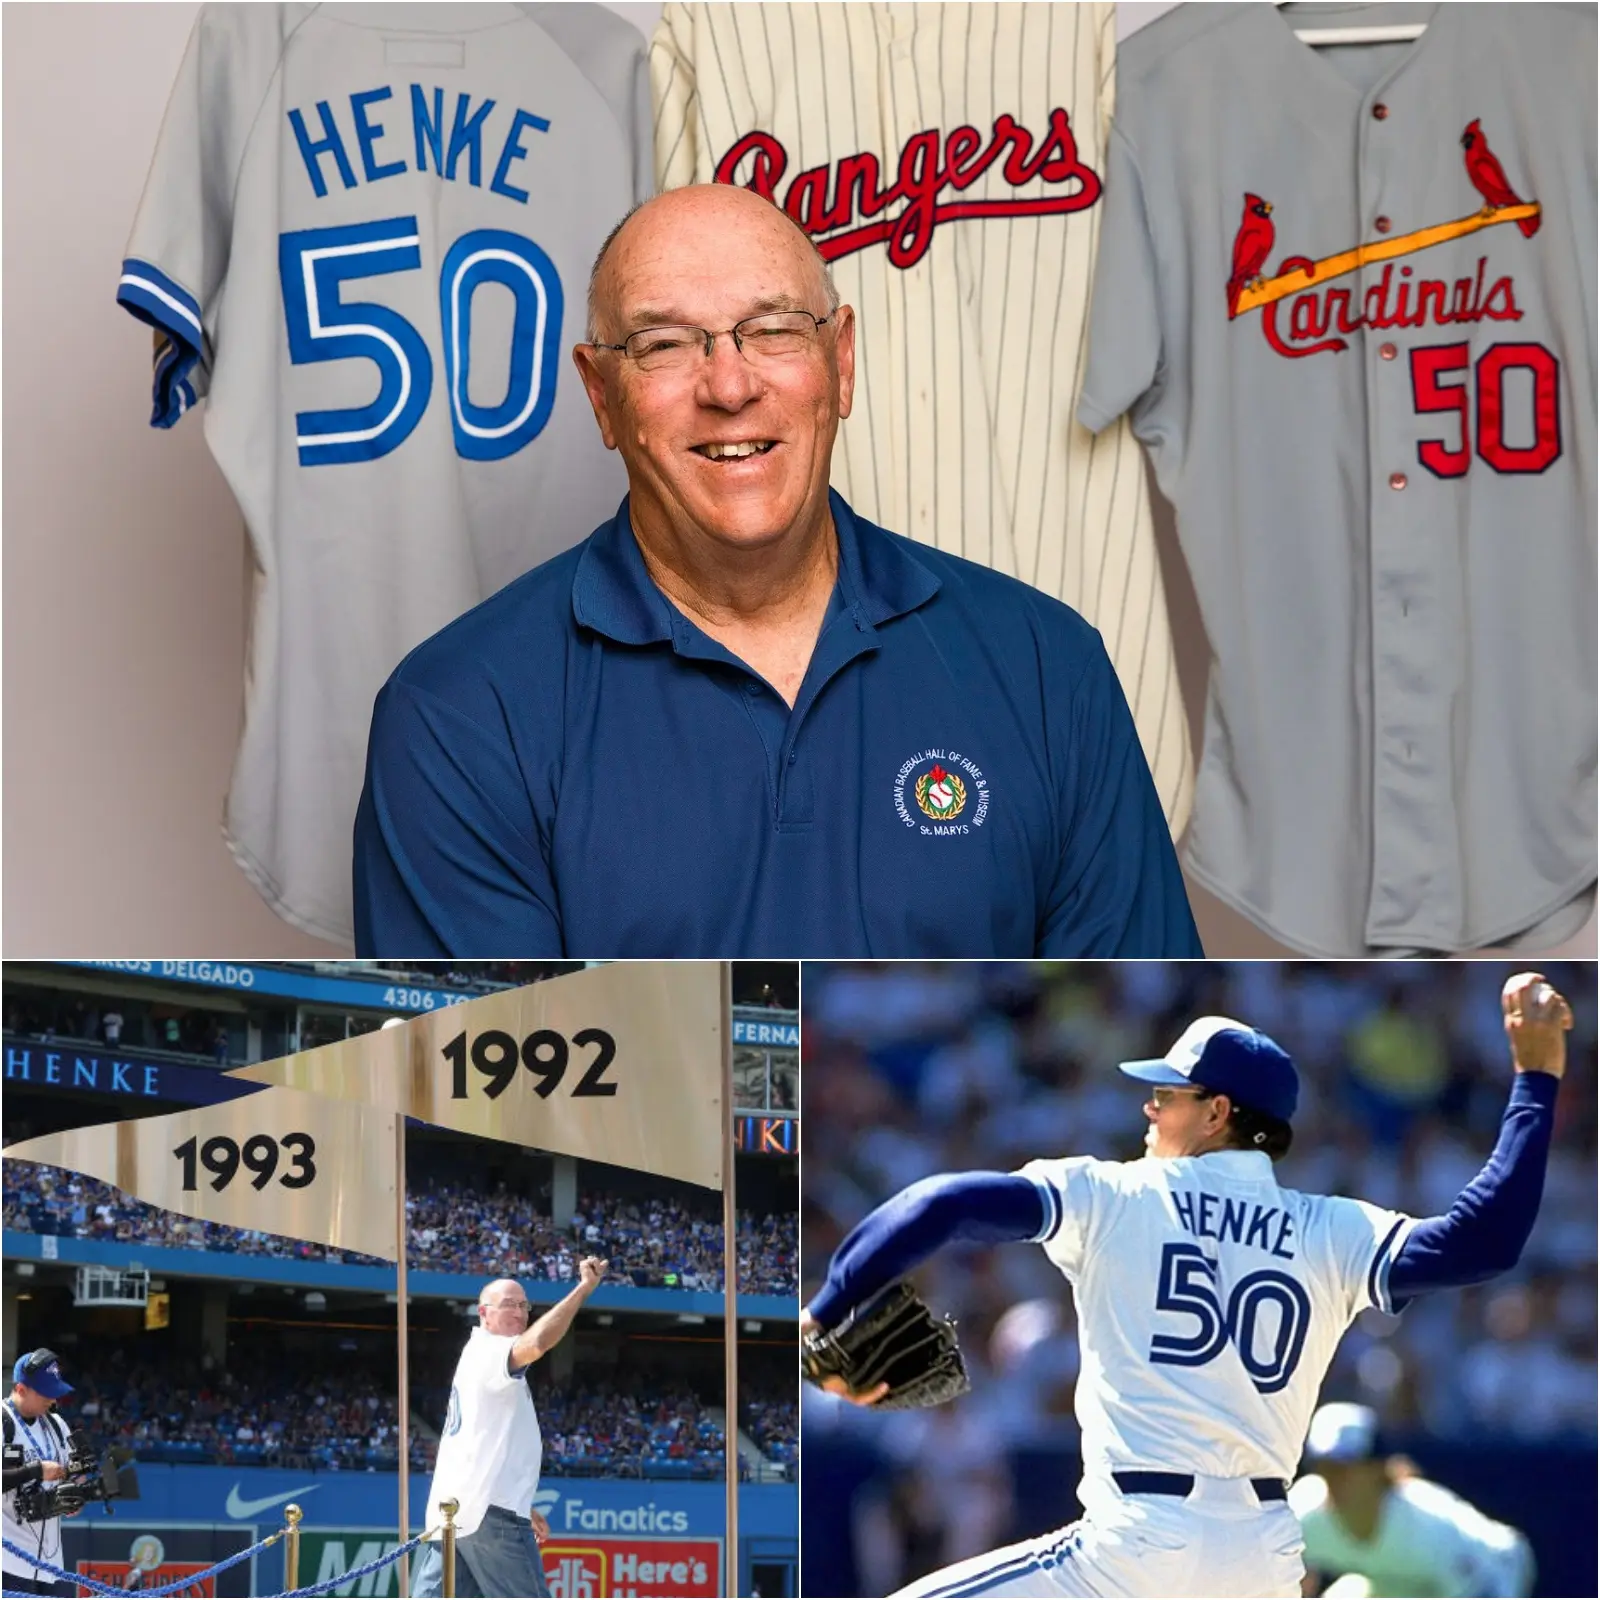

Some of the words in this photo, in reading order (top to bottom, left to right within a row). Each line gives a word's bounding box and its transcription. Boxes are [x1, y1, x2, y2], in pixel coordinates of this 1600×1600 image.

[288, 83, 550, 204] HENKE
[712, 107, 1103, 269] Rangers
[1262, 256, 1524, 358] Cardinals
[279, 215, 564, 466] 50
[1409, 341, 1562, 479] 50
[895, 752, 926, 786] BASEBALL
[925, 748, 946, 760] HALL
[948, 751, 962, 763] OF
[960, 758, 983, 780] FAME
[975, 780, 987, 790] &
[893, 786, 915, 828] CANADIAN
[972, 790, 990, 827] MUSEUM
[934, 824, 969, 836] MARYS
[162, 961, 254, 987] DELGADO
[383, 987, 435, 1010] 4306
[734, 1022, 799, 1045] FERNA
[6, 1048, 159, 1095] HENKE
[441, 1028, 618, 1100] 1992
[172, 1132, 316, 1193] 1993
[1171, 1191, 1294, 1260] HENKE
[1149, 1242, 1311, 1394] 50
[565, 1499, 688, 1532] Fanatics
[613, 1553, 708, 1585] Here's
